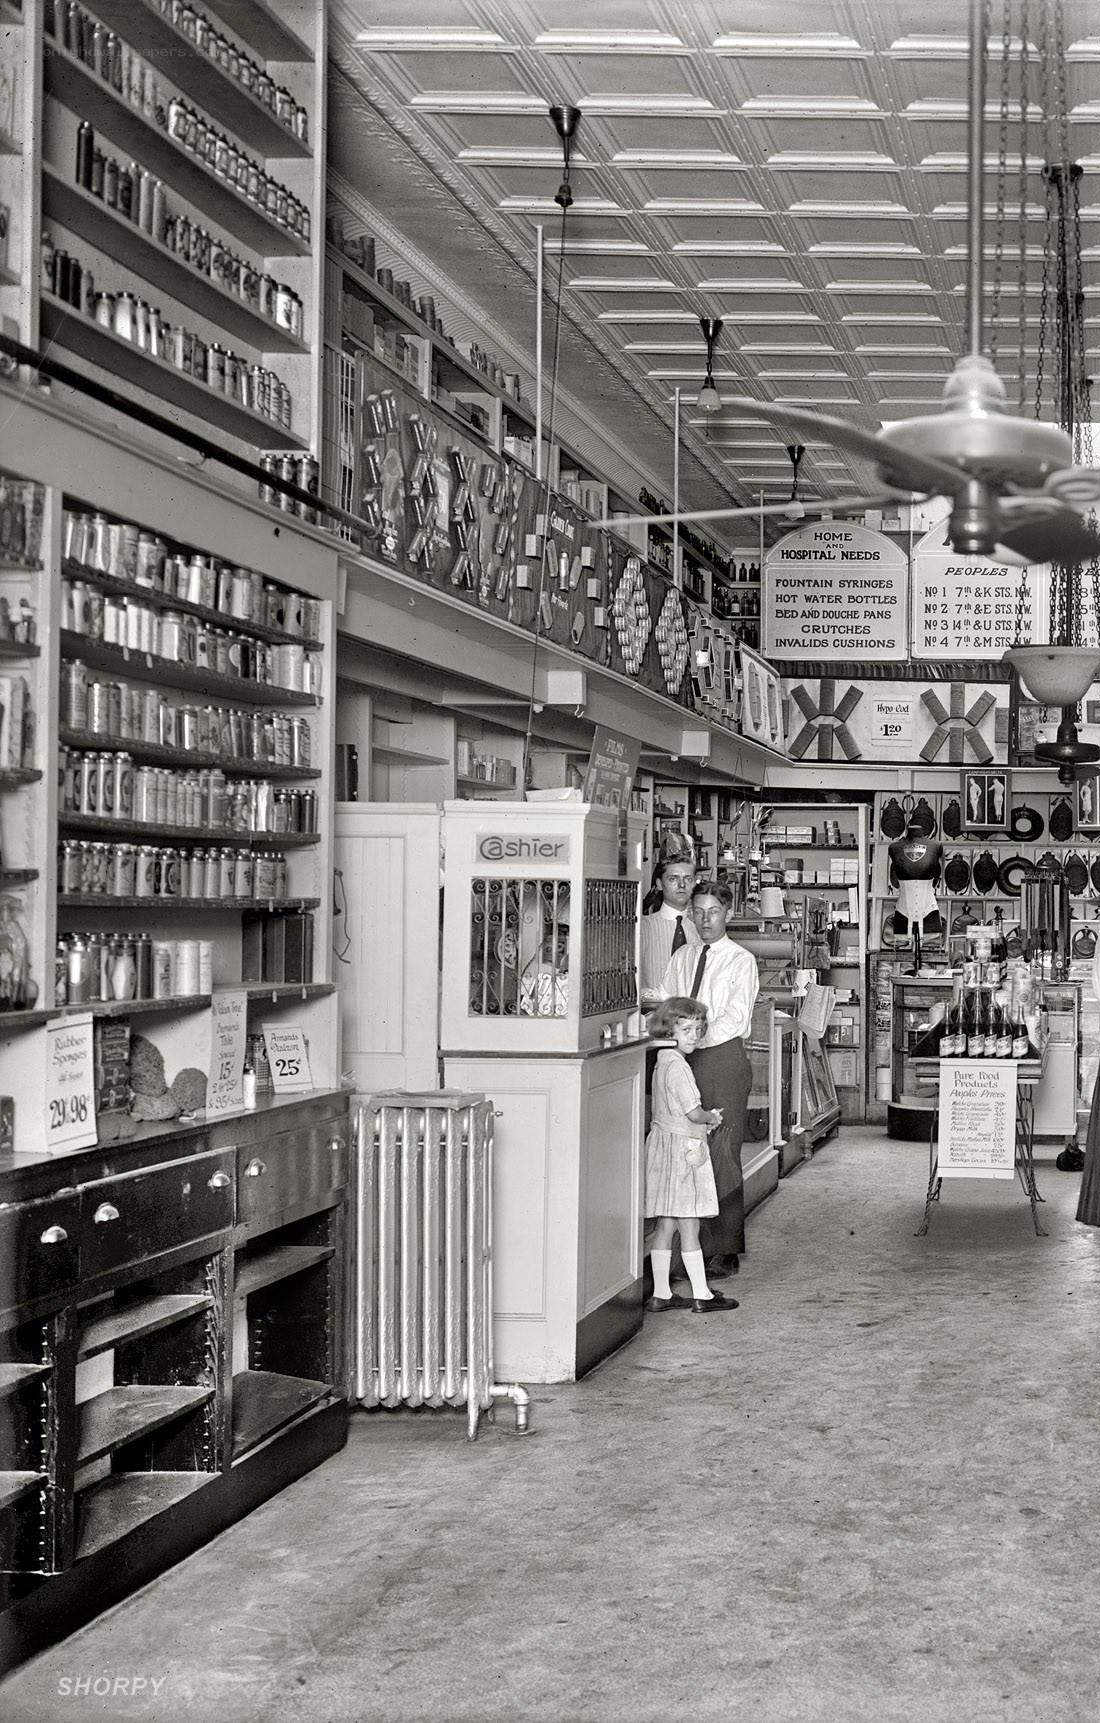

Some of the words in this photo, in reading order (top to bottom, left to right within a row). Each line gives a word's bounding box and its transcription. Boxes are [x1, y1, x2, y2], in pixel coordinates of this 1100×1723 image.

[814, 532, 853, 541] HOME
[781, 550, 836, 560] HOSPITAL
[841, 551, 881, 561] NEEDS
[944, 567, 1009, 576] PEOPLES
[775, 578, 833, 588] FOUNTAIN
[838, 579, 894, 589] SYRINGES
[942, 587, 947, 598] 1
[994, 587, 1013, 598] STS.
[1015, 587, 1032, 598] NW.
[775, 594, 798, 604] HOT
[804, 594, 843, 604] WATER
[847, 595, 898, 605] BOTTLES
[941, 604, 948, 614] 2
[994, 604, 1014, 614] STS.
[775, 609, 798, 619] BED
[800, 609, 820, 619] AND
[822, 610, 860, 620] DOUCHE
[863, 610, 892, 620] PANS
[801, 624, 871, 634] CRUTCHES
[940, 620, 949, 630] 3
[994, 620, 1014, 630] STS.
[775, 638, 829, 648] INVALIDS
[833, 639, 896, 648] CUSHIONS
[940, 636, 949, 647] 4
[479, 836, 565, 860] Cashier
[54, 1034, 87, 1051] Rubber
[52, 1051, 87, 1067] Sponges
[954, 1070, 975, 1080] Pure
[979, 1071, 1000, 1080] Food
[954, 1080, 999, 1088] Products
[980, 1089, 1007, 1098] Prices
